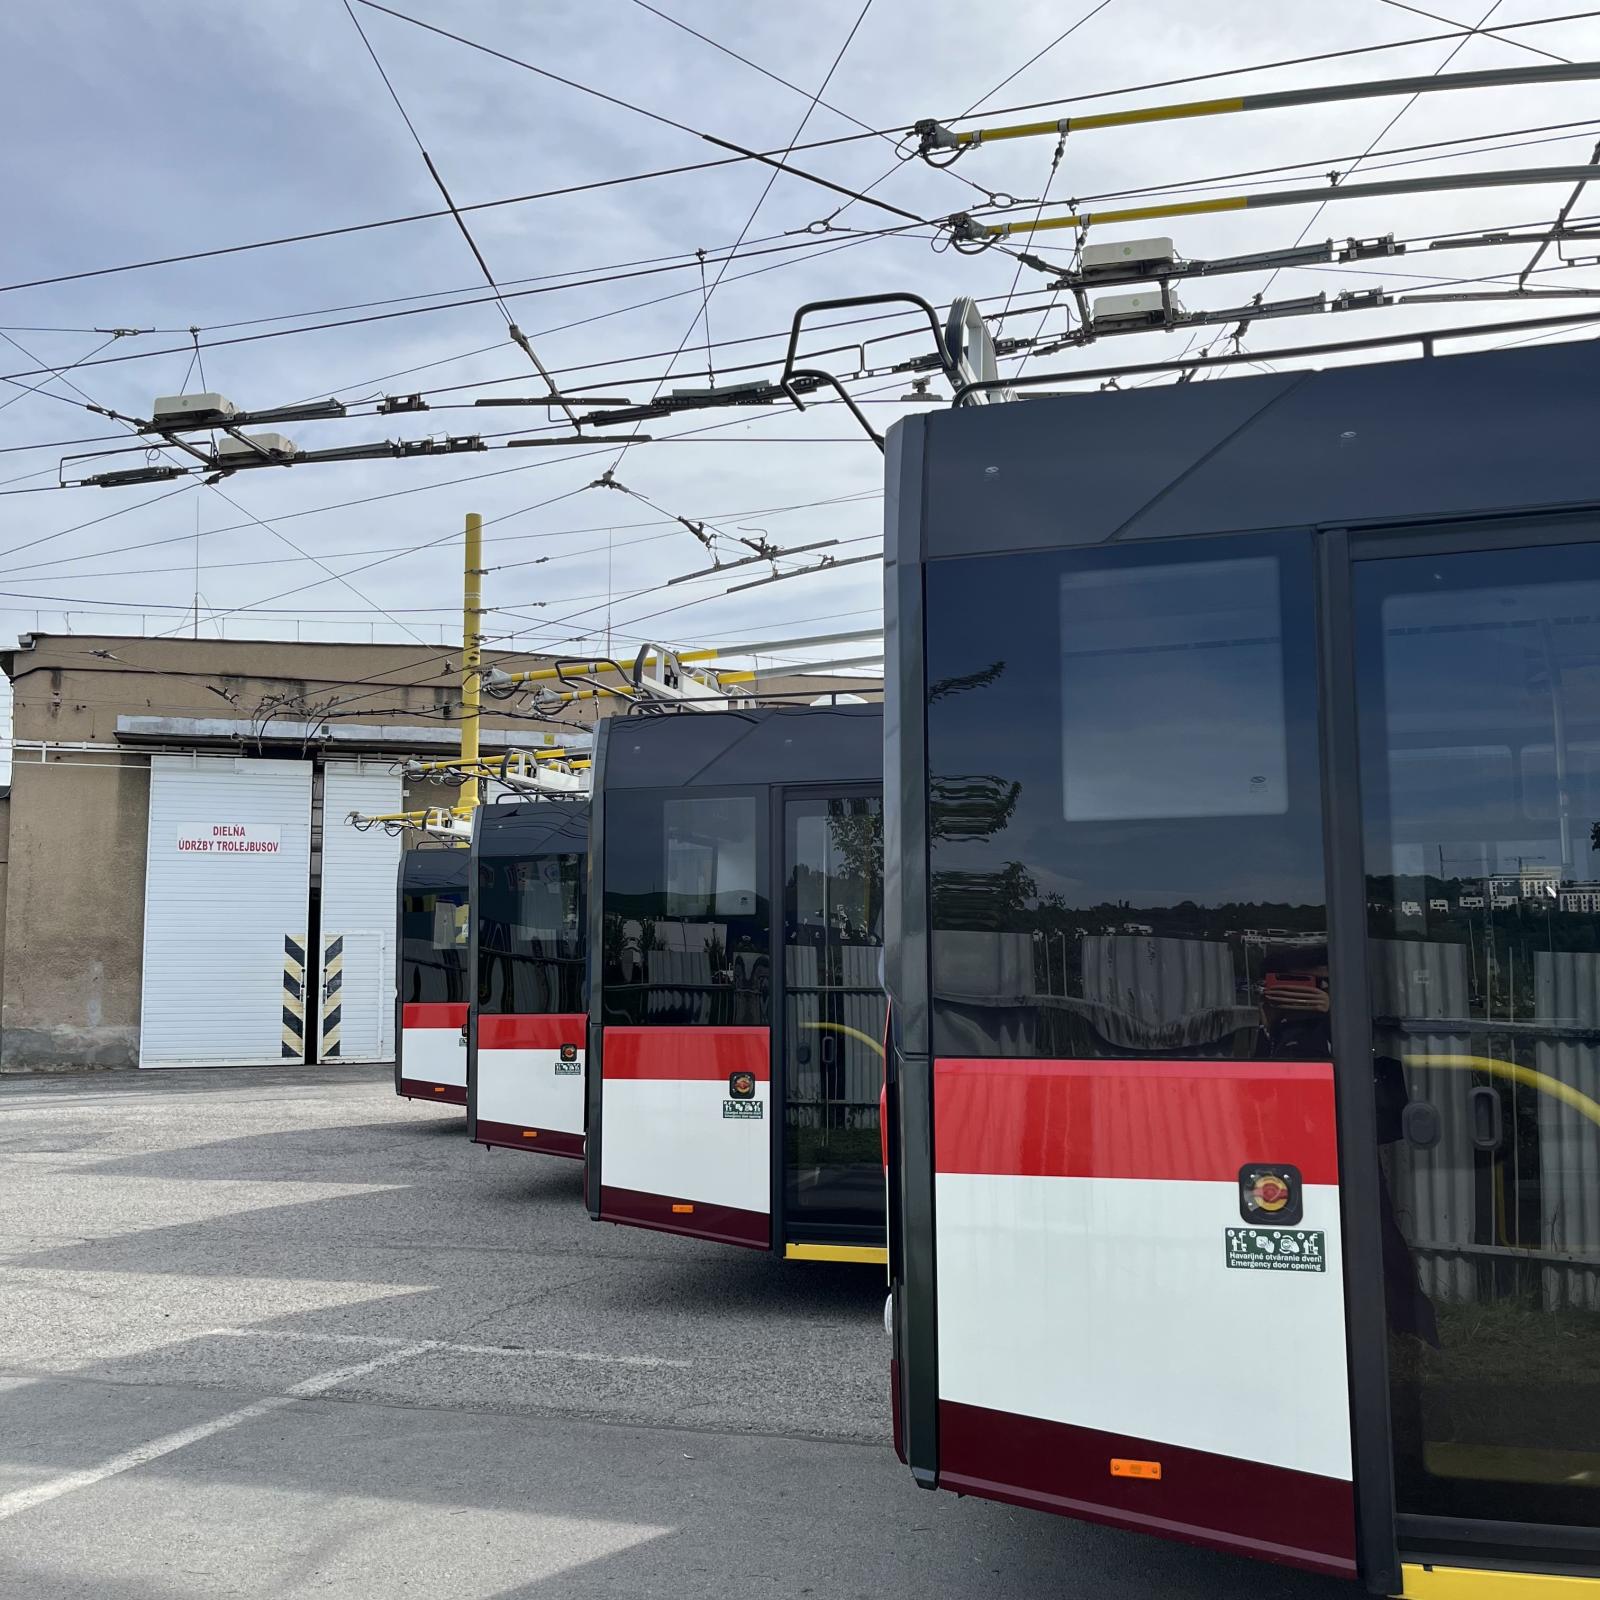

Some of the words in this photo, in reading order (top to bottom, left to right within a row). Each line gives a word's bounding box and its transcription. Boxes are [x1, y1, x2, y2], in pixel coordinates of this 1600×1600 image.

[213, 824, 246, 836] DIELŇA
[178, 838, 214, 851] ÚDRŽBY
[217, 841, 279, 852] TROLEJBUSOV
[1229, 1252, 1264, 1260] Havarijné
[1265, 1253, 1300, 1262] otváranie
[1231, 1259, 1271, 1269] Emergency
[1272, 1261, 1290, 1269] door
[1291, 1262, 1322, 1272] opening
